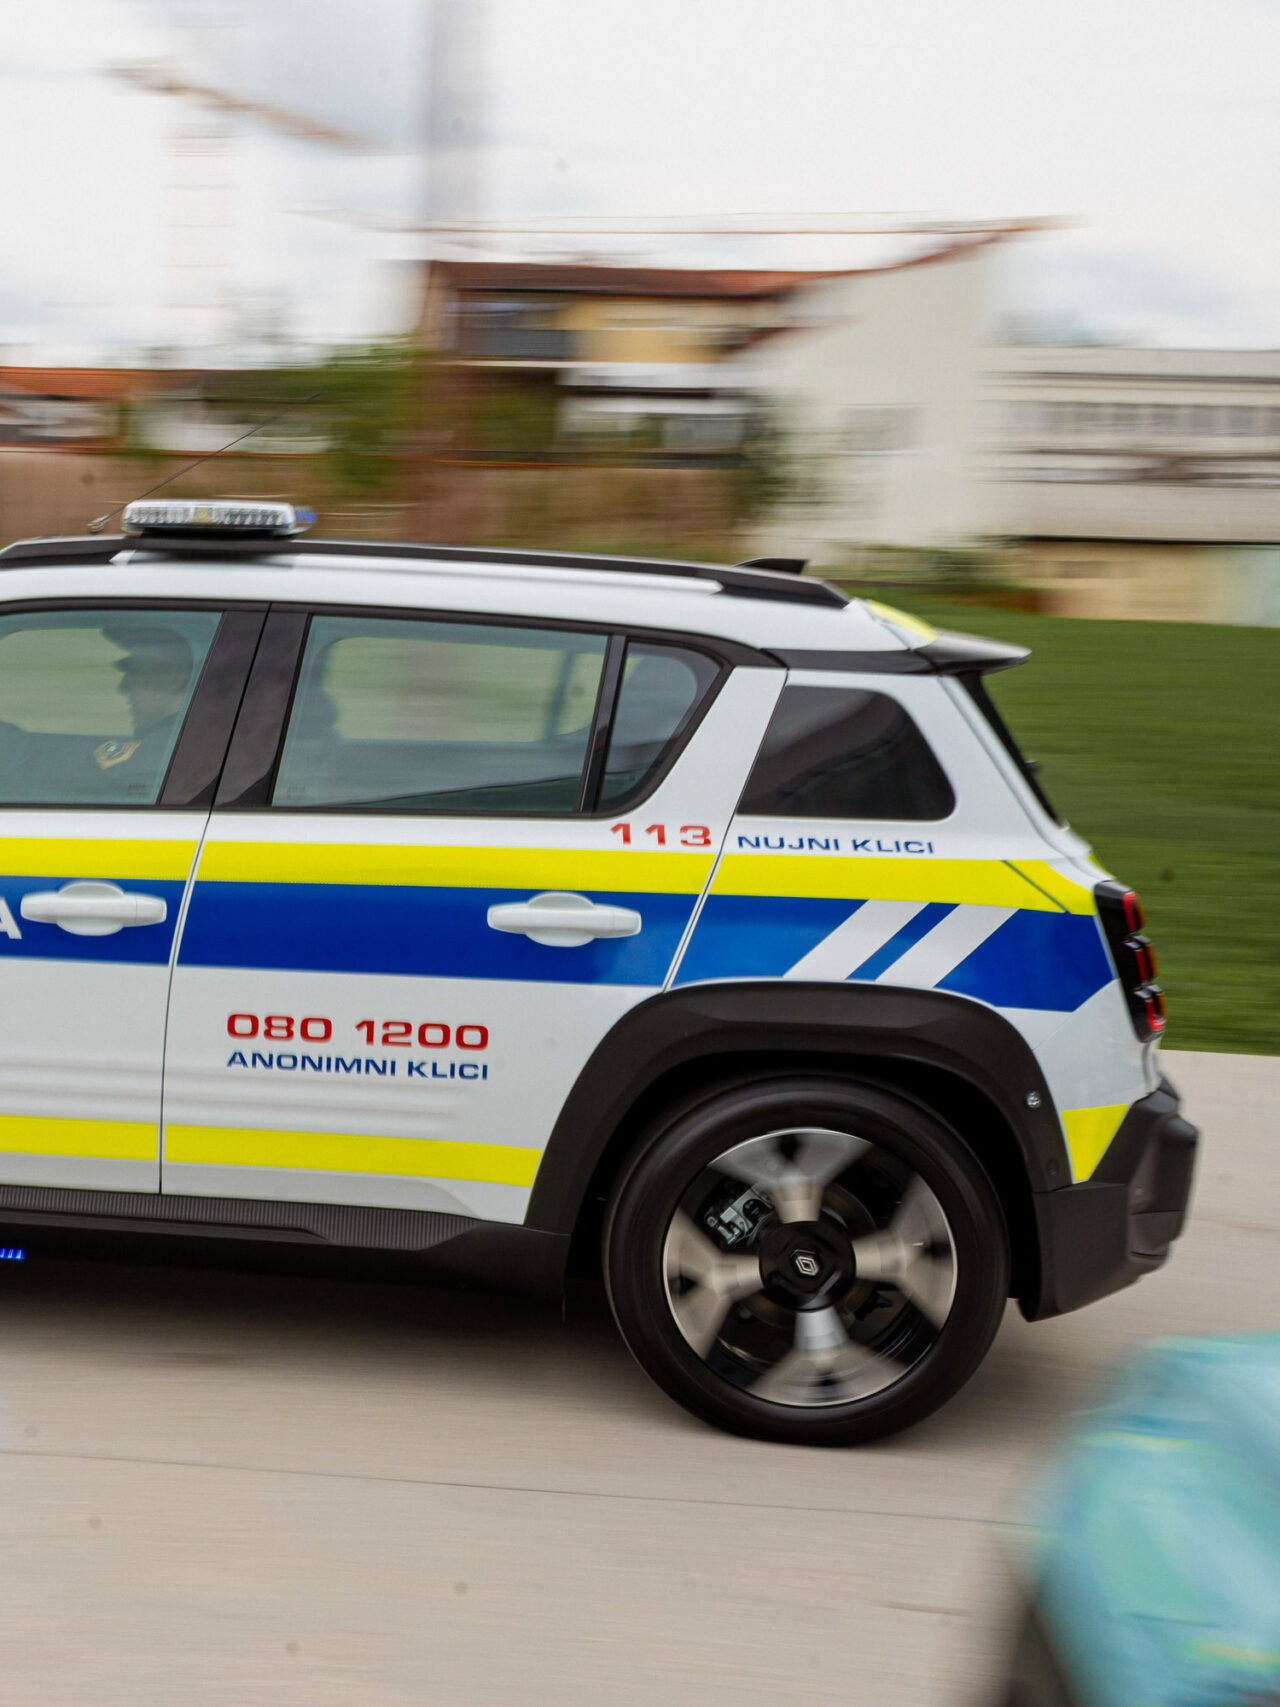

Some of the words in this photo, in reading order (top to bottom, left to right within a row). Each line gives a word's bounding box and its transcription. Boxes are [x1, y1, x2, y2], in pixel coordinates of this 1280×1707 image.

[610, 822, 712, 848] 113
[737, 834, 840, 852] NUJNI
[851, 838, 935, 855] KLICI
[226, 1012, 334, 1044] 080
[354, 1018, 490, 1052] 1200
[226, 1050, 397, 1076] ANONIMNI
[407, 1059, 489, 1081] KLICI
